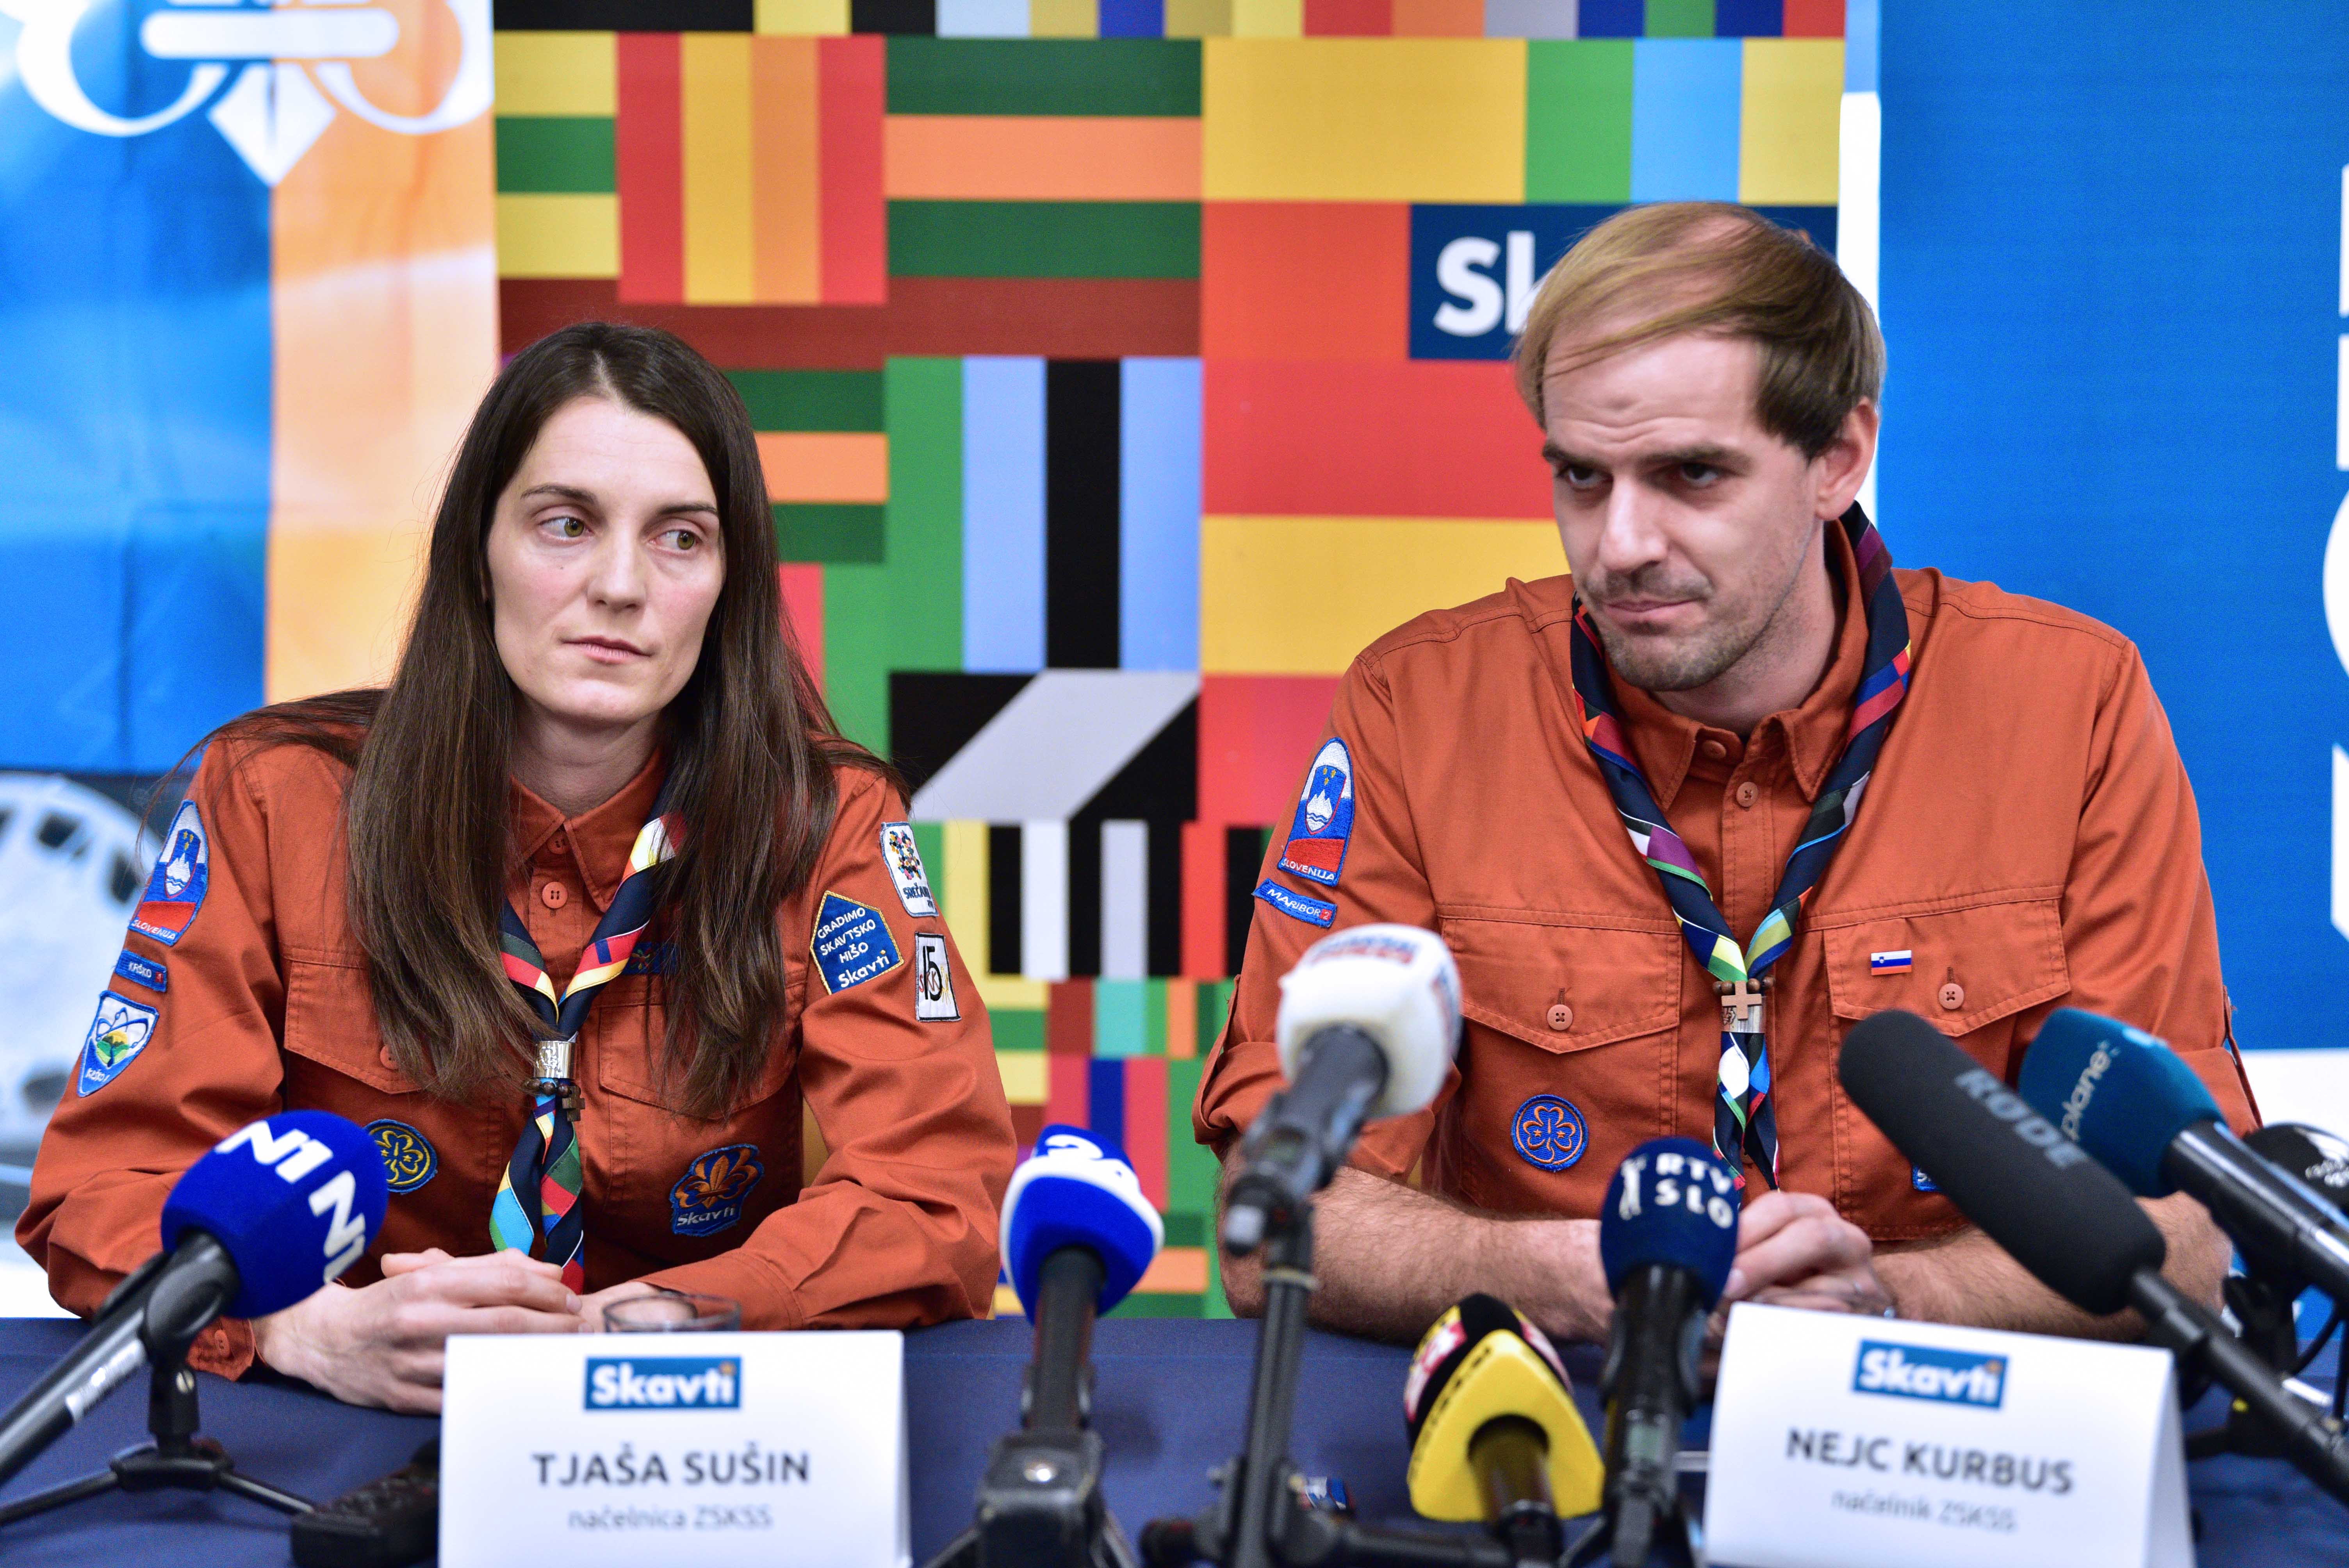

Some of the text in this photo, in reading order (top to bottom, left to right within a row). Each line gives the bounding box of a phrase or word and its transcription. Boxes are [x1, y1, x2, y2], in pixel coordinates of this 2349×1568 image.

[1281, 858, 1335, 880] SLOVENIJA
[1267, 889, 1330, 920] MARIBOR 2
[131, 919, 176, 940] SLOVENIJA
[818, 907, 866, 939] GRADIMO
[820, 919, 876, 956] SKAVTSKO
[838, 950, 890, 987] Skavti
[839, 942, 868, 963] HIŠO
[215, 1120, 333, 1183] N1
[676, 1204, 736, 1226] Skavti
[1655, 1178, 1734, 1229] SLO
[592, 1361, 736, 1406] Skavti
[1859, 1347, 2002, 1402] Skavti
[532, 1441, 809, 1486] TJAŠA SUŠIN
[1786, 1427, 2075, 1496] NEJC KURBUS
[568, 1504, 686, 1530] načelnica
[1831, 1488, 1931, 1521] načelnik
